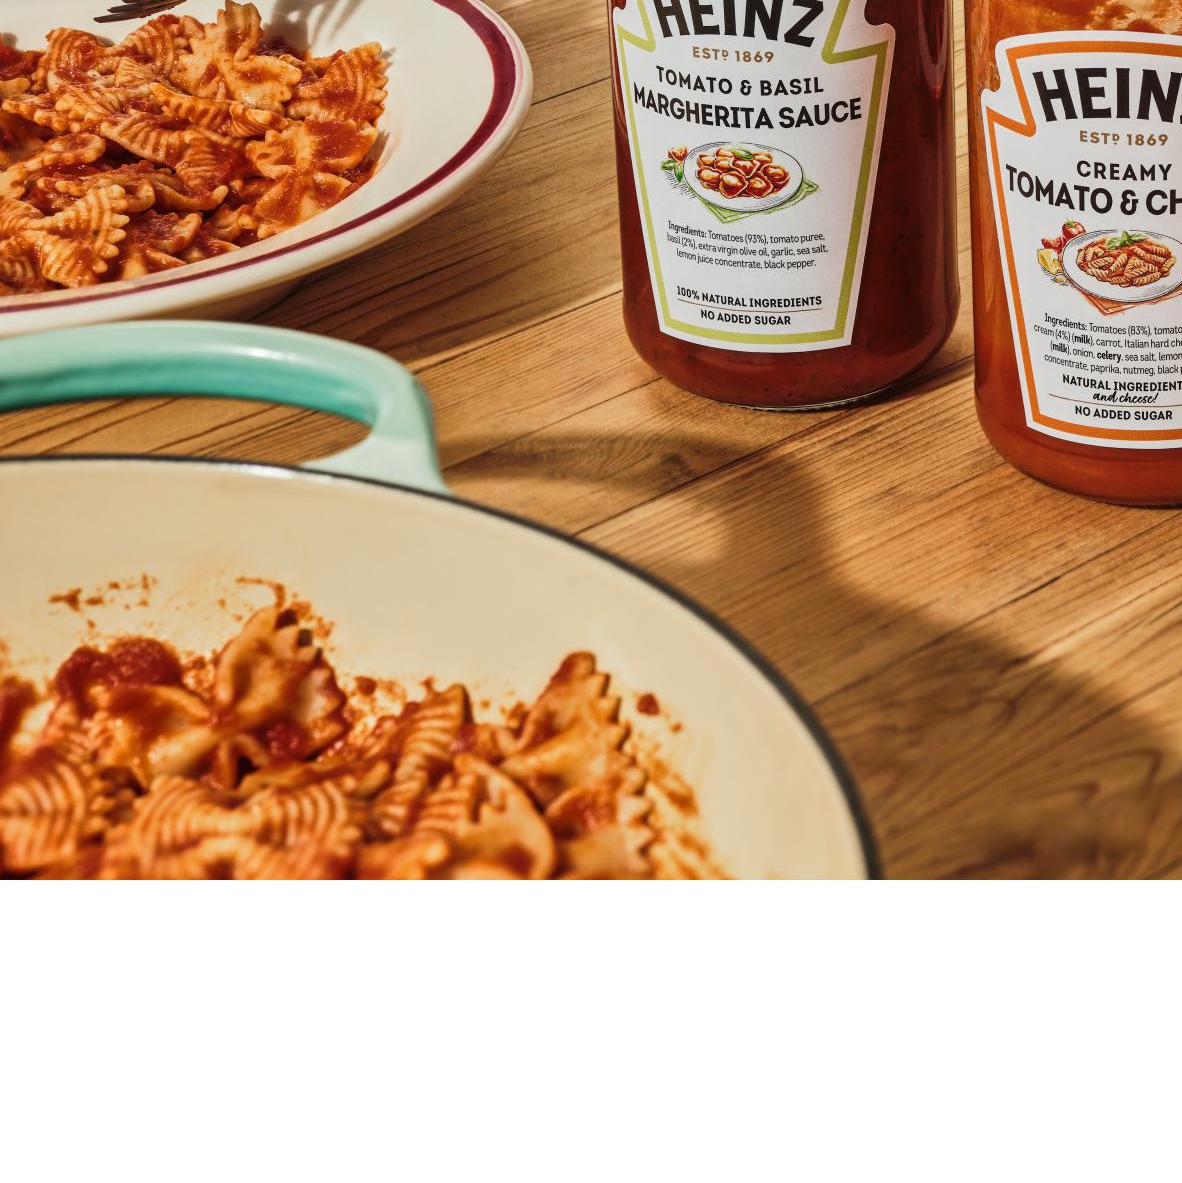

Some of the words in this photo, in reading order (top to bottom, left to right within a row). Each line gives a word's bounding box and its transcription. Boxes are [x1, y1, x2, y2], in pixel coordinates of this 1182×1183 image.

[735, 50, 774, 63] 1869
[656, 65, 732, 95] TOMATO
[739, 80, 752, 96] &
[760, 76, 824, 96] BASIL
[633, 82, 774, 129] MARGHERITA
[779, 97, 862, 129] SAUCE
[1127, 133, 1168, 146] 1869
[1076, 160, 1172, 181] CREAMY
[1005, 164, 1112, 214] TOMATO
[1120, 189, 1138, 215] &
[668, 220, 707, 238] Ingredients:
[707, 229, 744, 242] Tomatoes
[744, 233, 768, 245] (93%),
[770, 235, 799, 244] tomato
[666, 232, 681, 244] basil
[698, 243, 717, 252] extra
[717, 245, 738, 256] virgin
[739, 246, 756, 255] olive
[758, 247, 769, 257] oil,
[770, 247, 795, 258] garlic,
[797, 247, 810, 255] sea
[676, 248, 697, 261] lemon
[697, 253, 714, 264] juice
[714, 258, 763, 269] concentrate,
[764, 260, 785, 269] black
[786, 259, 816, 270] pepper.
[676, 285, 700, 300] 100%
[701, 292, 747, 307] NATURAL
[749, 295, 822, 308] INGREDIENTS
[700, 309, 715, 320] NO
[717, 313, 751, 324] ADDED
[754, 315, 791, 325] SUGAR
[1044, 312, 1087, 331] Ingredients:
[1089, 322, 1127, 335] Tomatoes
[1154, 326, 1182, 335] tomato
[1033, 324, 1054, 337] cream
[1055, 329, 1071, 343] (4%)
[1095, 338, 1123, 348] carrot,
[1124, 339, 1149, 348] Italian
[1150, 339, 1169, 348] hard
[1044, 354, 1089, 371] concentrate,
[1090, 364, 1121, 374] paprika,
[1123, 365, 1155, 376] nutmeg,
[1157, 365, 1178, 374] black
[1072, 348, 1095, 359] onion,
[1124, 353, 1138, 361] sea
[1140, 352, 1157, 362] salt,
[1158, 352, 1182, 361] lemon
[1062, 374, 1111, 391] NATURAL
[1092, 390, 1118, 402] and
[1118, 391, 1158, 404] cheese!
[1075, 405, 1090, 417] NO
[1093, 408, 1131, 420] ADDED
[1134, 410, 1173, 420] SUGAR
